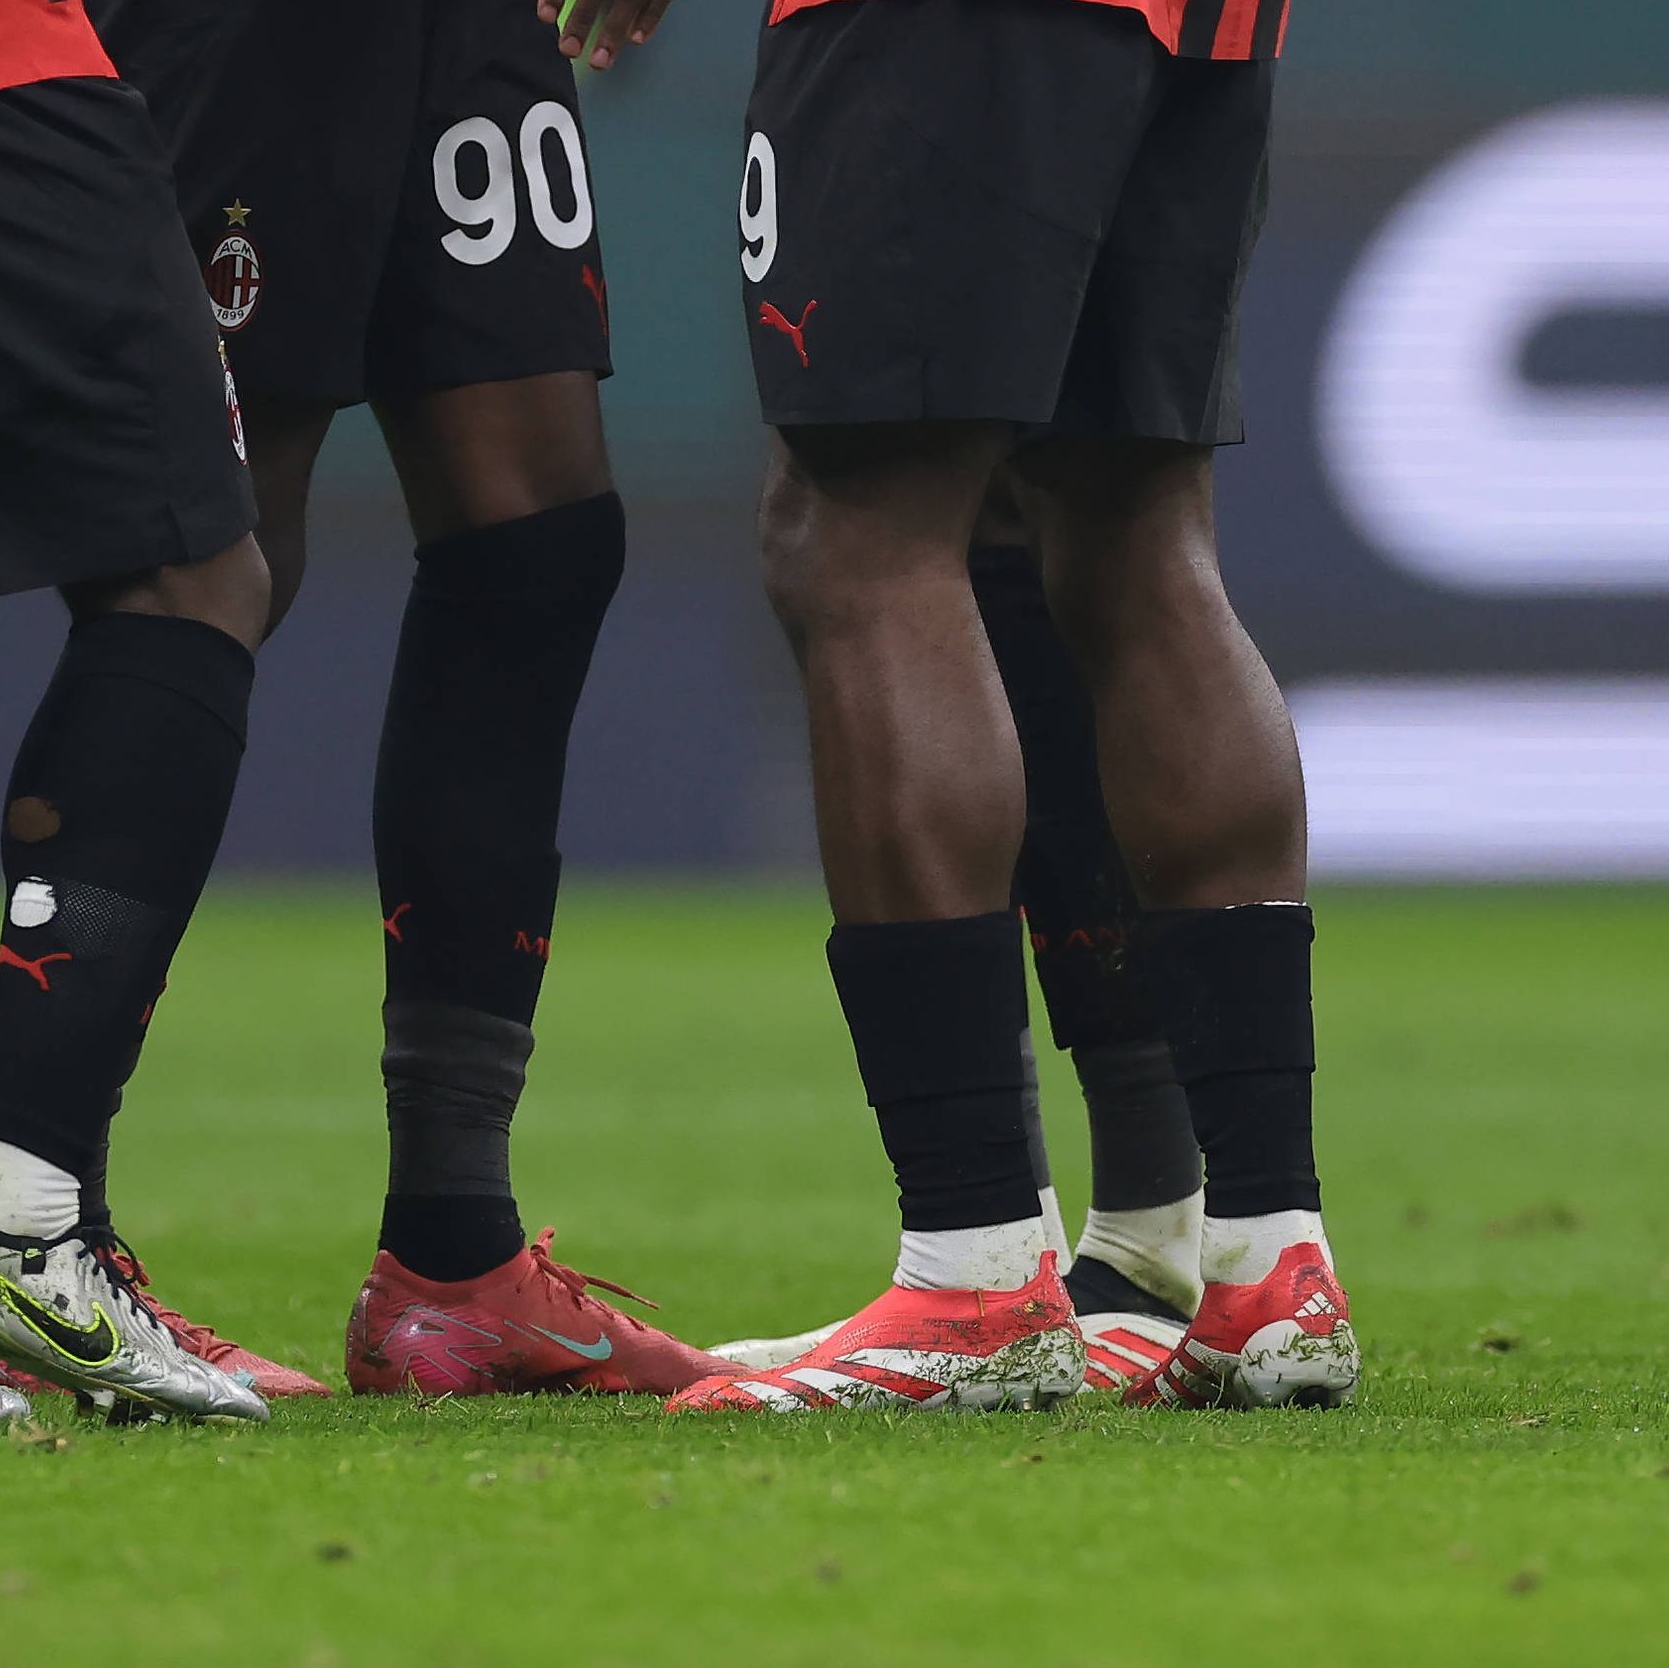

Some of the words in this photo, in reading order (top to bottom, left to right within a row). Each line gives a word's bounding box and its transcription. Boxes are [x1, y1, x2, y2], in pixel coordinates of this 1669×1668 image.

[432, 100, 595, 266] 90
[739, 131, 778, 283] 9
[219, 238, 254, 257] ACM
[217, 307, 245, 322] 1899
